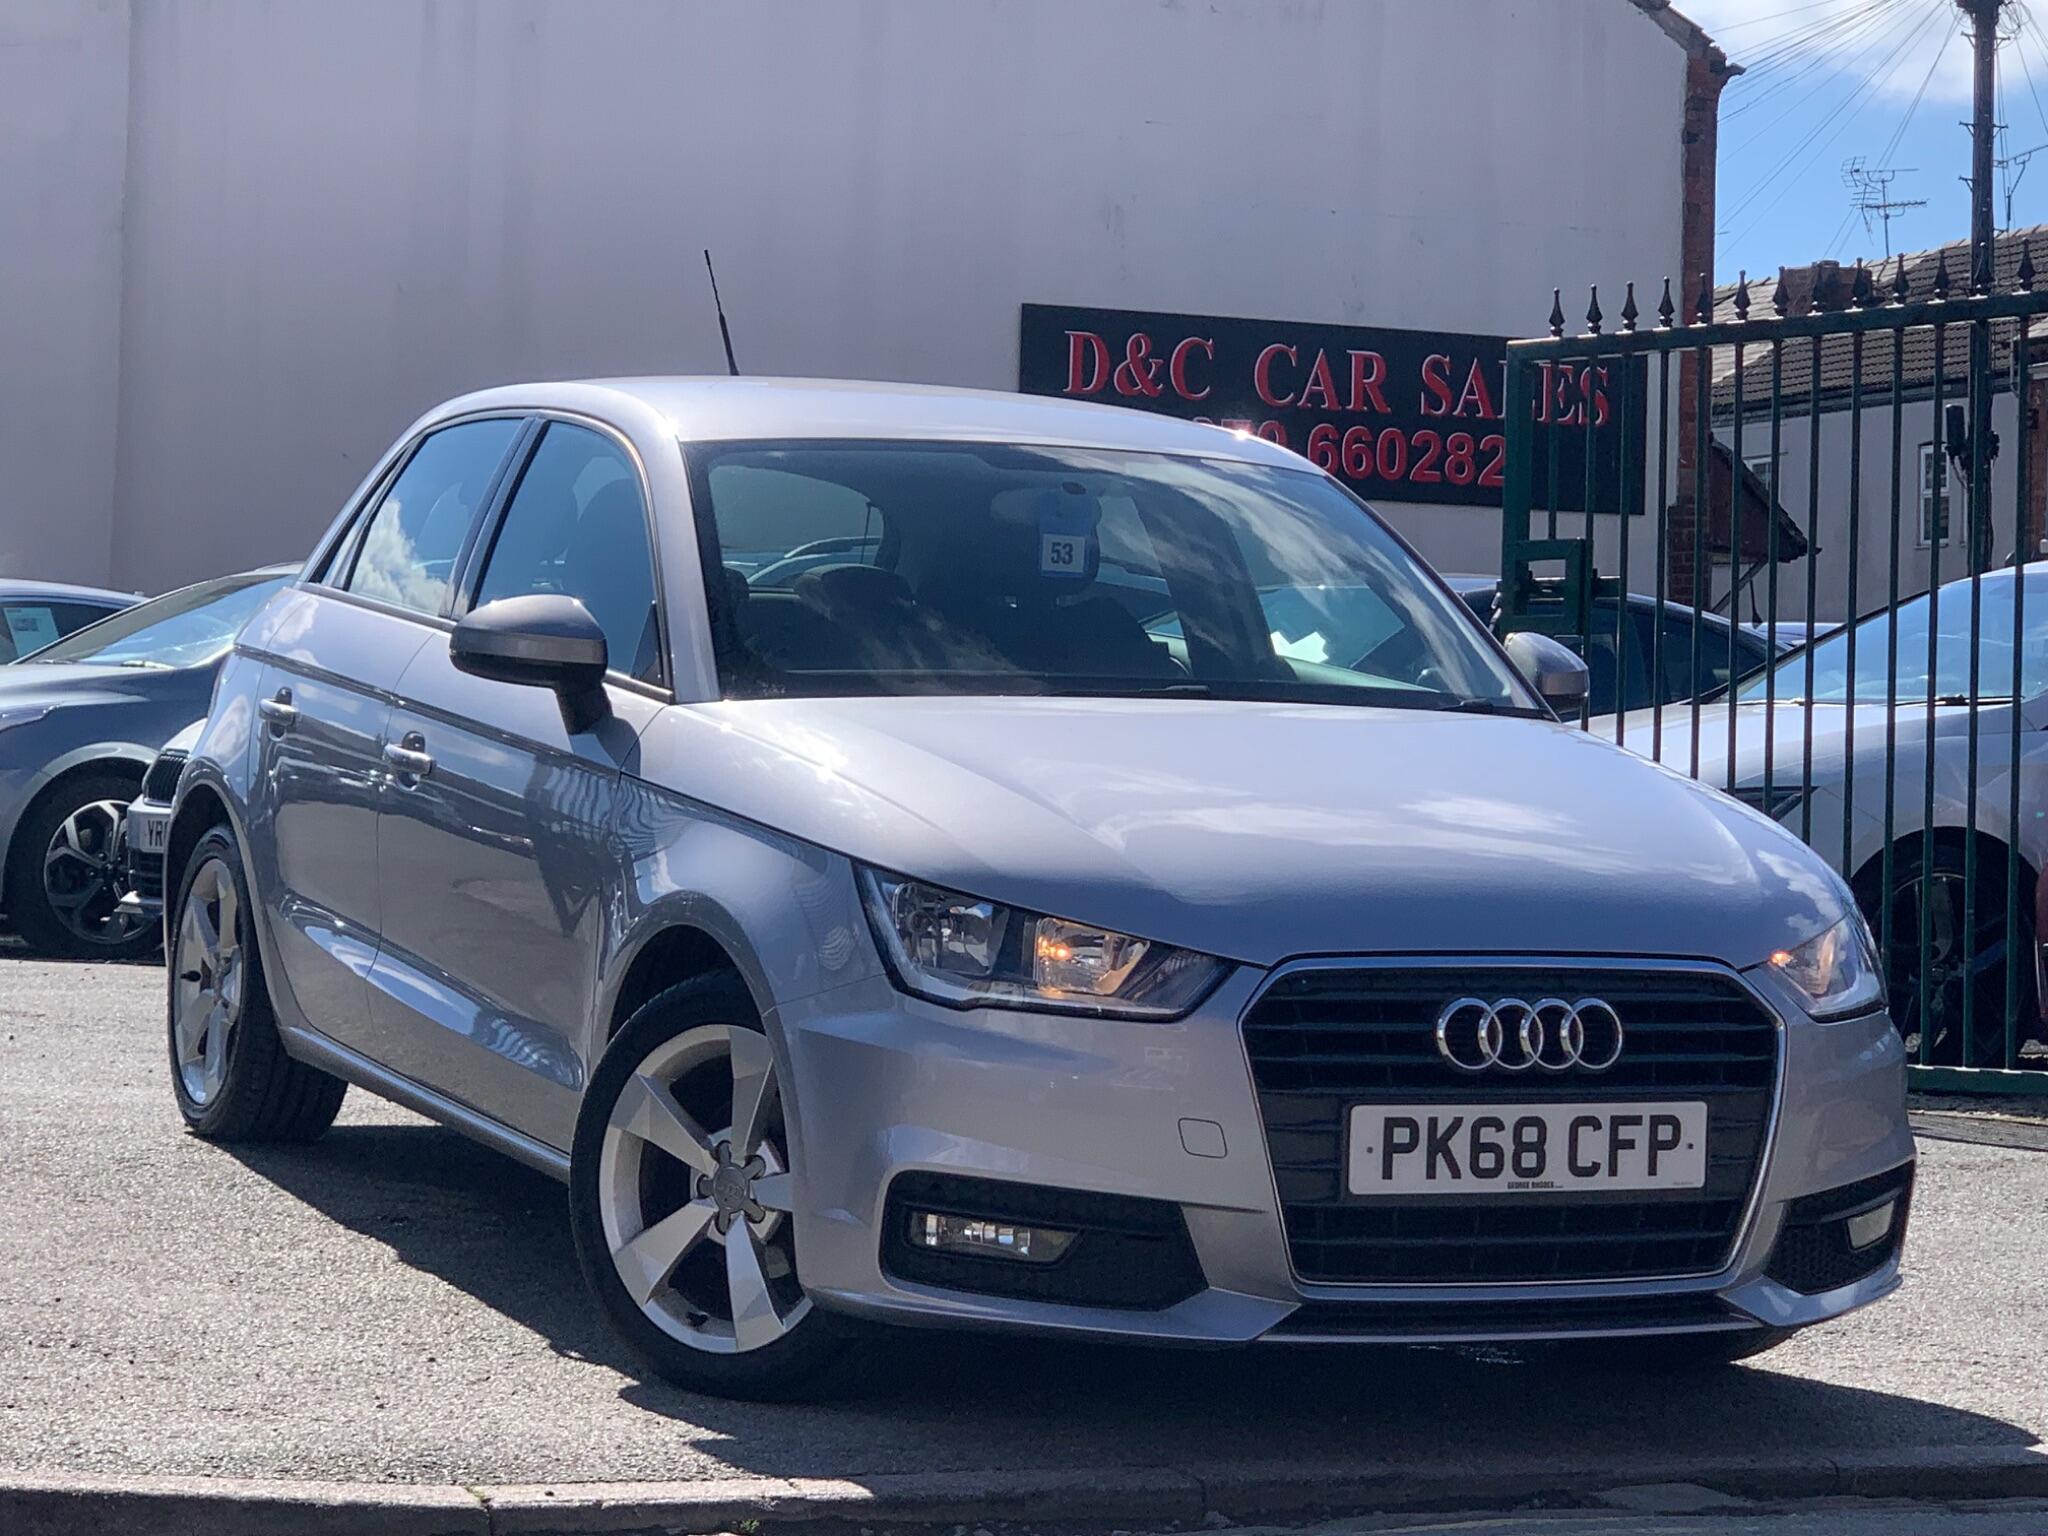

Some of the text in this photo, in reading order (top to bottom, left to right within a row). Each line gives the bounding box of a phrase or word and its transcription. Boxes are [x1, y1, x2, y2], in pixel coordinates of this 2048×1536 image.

[1063, 330, 1609, 426] D&C CAR SAES
[1308, 423, 1506, 487] 660282
[1050, 542, 1074, 565] 53
[1381, 1115, 1682, 1180] PK68 CFP
